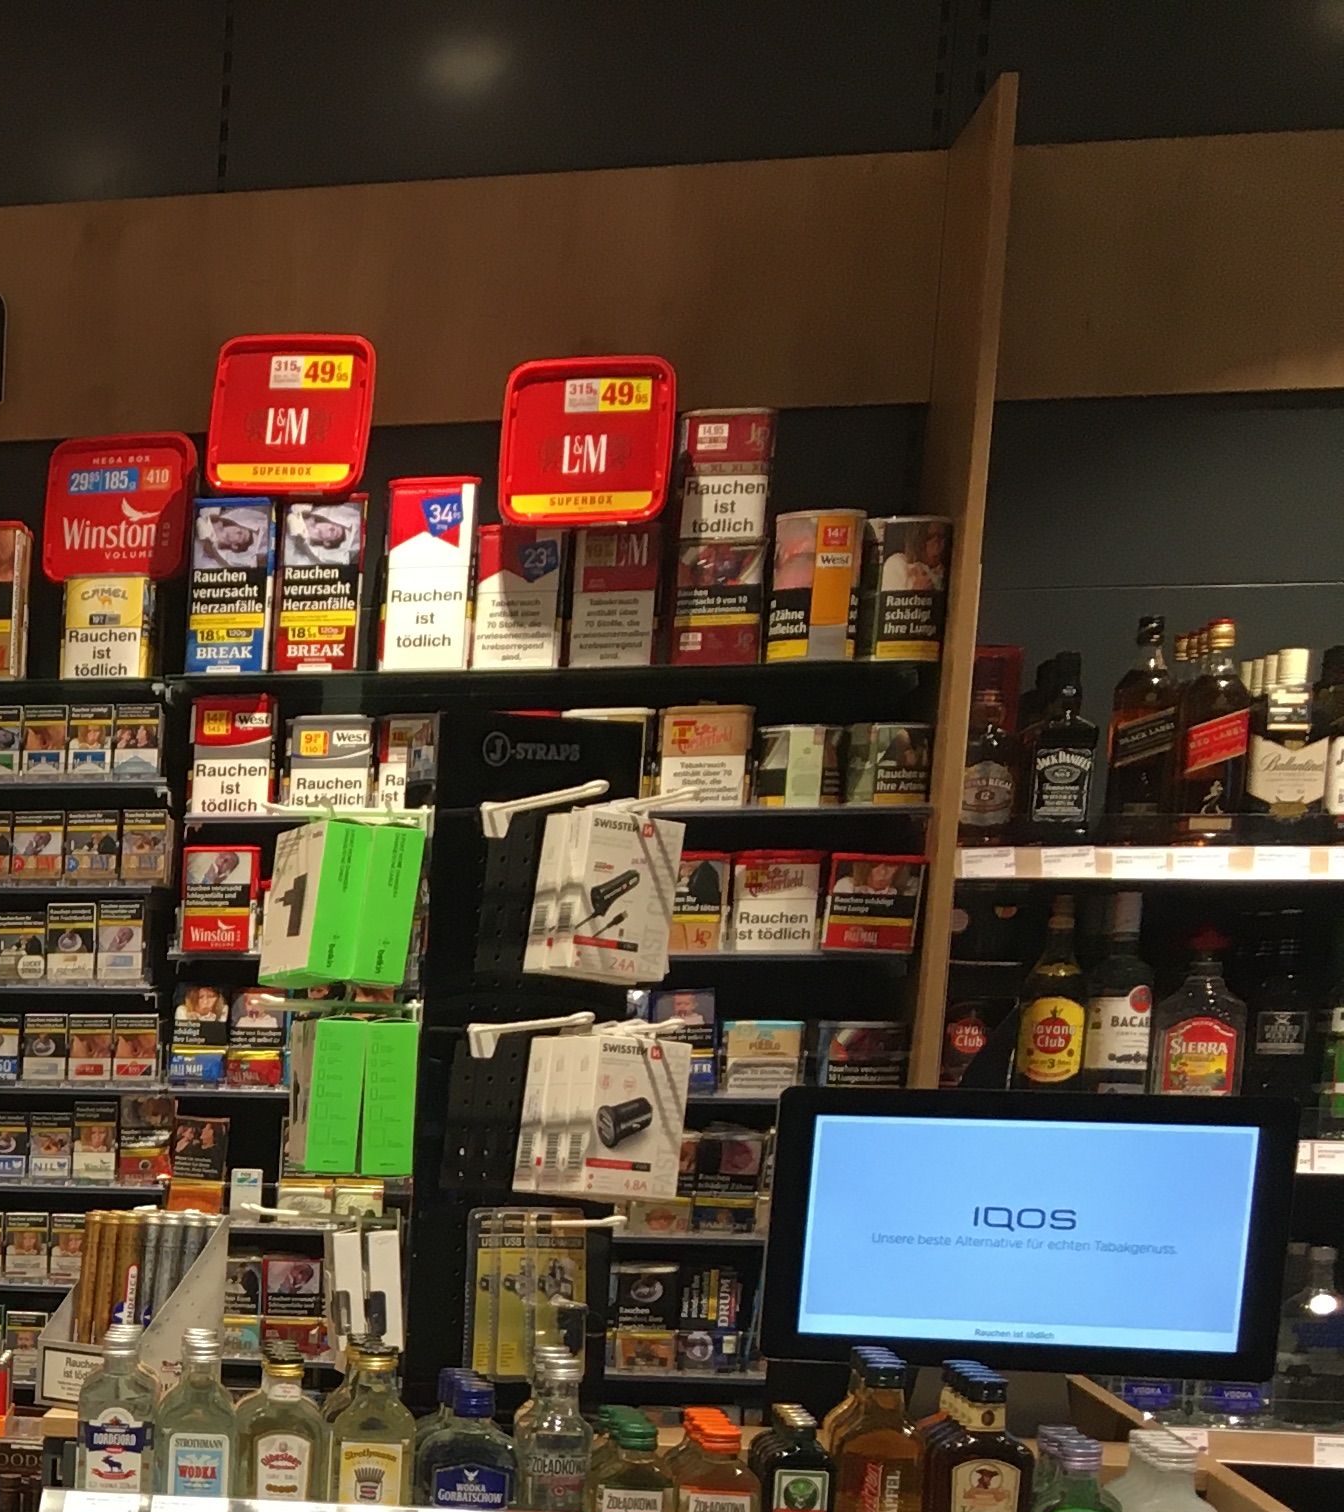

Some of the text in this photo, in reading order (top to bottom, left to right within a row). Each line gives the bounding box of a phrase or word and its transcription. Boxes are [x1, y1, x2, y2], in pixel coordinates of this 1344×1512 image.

[265, 407, 309, 446] L&M
[93, 455, 151, 465] MEGA BOX
[562, 433, 607, 475] L&M
[252, 465, 312, 476] SUPERBOX
[686, 479, 766, 496] Rauchen
[549, 495, 613, 507] SUPERBOX
[714, 498, 736, 515] ist
[692, 516, 755, 534] tödlich
[63, 516, 156, 551] Winston
[105, 549, 154, 560] VOLUME
[193, 569, 247, 584] Rauchen
[284, 566, 339, 581] Rauchen
[81, 588, 128, 601] CAMEL
[193, 584, 258, 599] verursacht
[283, 582, 350, 596] verursacht
[391, 588, 463, 604] Rauchen
[192, 599, 262, 615] Herzanfälle
[282, 597, 355, 612] Herzanfälle
[886, 594, 933, 607] Rauchen
[415, 611, 435, 625] ist
[885, 607, 931, 623] schädigt
[69, 629, 136, 643] Rauchen
[396, 633, 451, 649] tödlich
[92, 646, 111, 660] ist
[196, 645, 252, 660] BREAK
[286, 643, 345, 658] BREAK
[74, 661, 127, 677] tödlich
[238, 714, 270, 728] West
[335, 731, 368, 746] West
[196, 764, 267, 777] Rauchen
[220, 782, 240, 794] ist
[296, 778, 362, 790] Rauchen
[202, 798, 257, 813] tödlich
[739, 912, 808, 925] Rauchen
[190, 926, 235, 943] Winston
[758, 927, 811, 941] tödlich
[1169, 1039, 1228, 1056] SIERRA
[973, 1206, 1077, 1232] IQOS
[872, 1232, 1178, 1256] Unsere beste Alternative für echten Tabakgenuss.
[719, 1271, 731, 1329] DRUM
[975, 1328, 1055, 1341] Rauchen ist tödlich
[175, 1438, 223, 1449] STROTHMANN
[178, 1465, 217, 1479] WODKA
[438, 1488, 503, 1504] GORBATSCHOW
